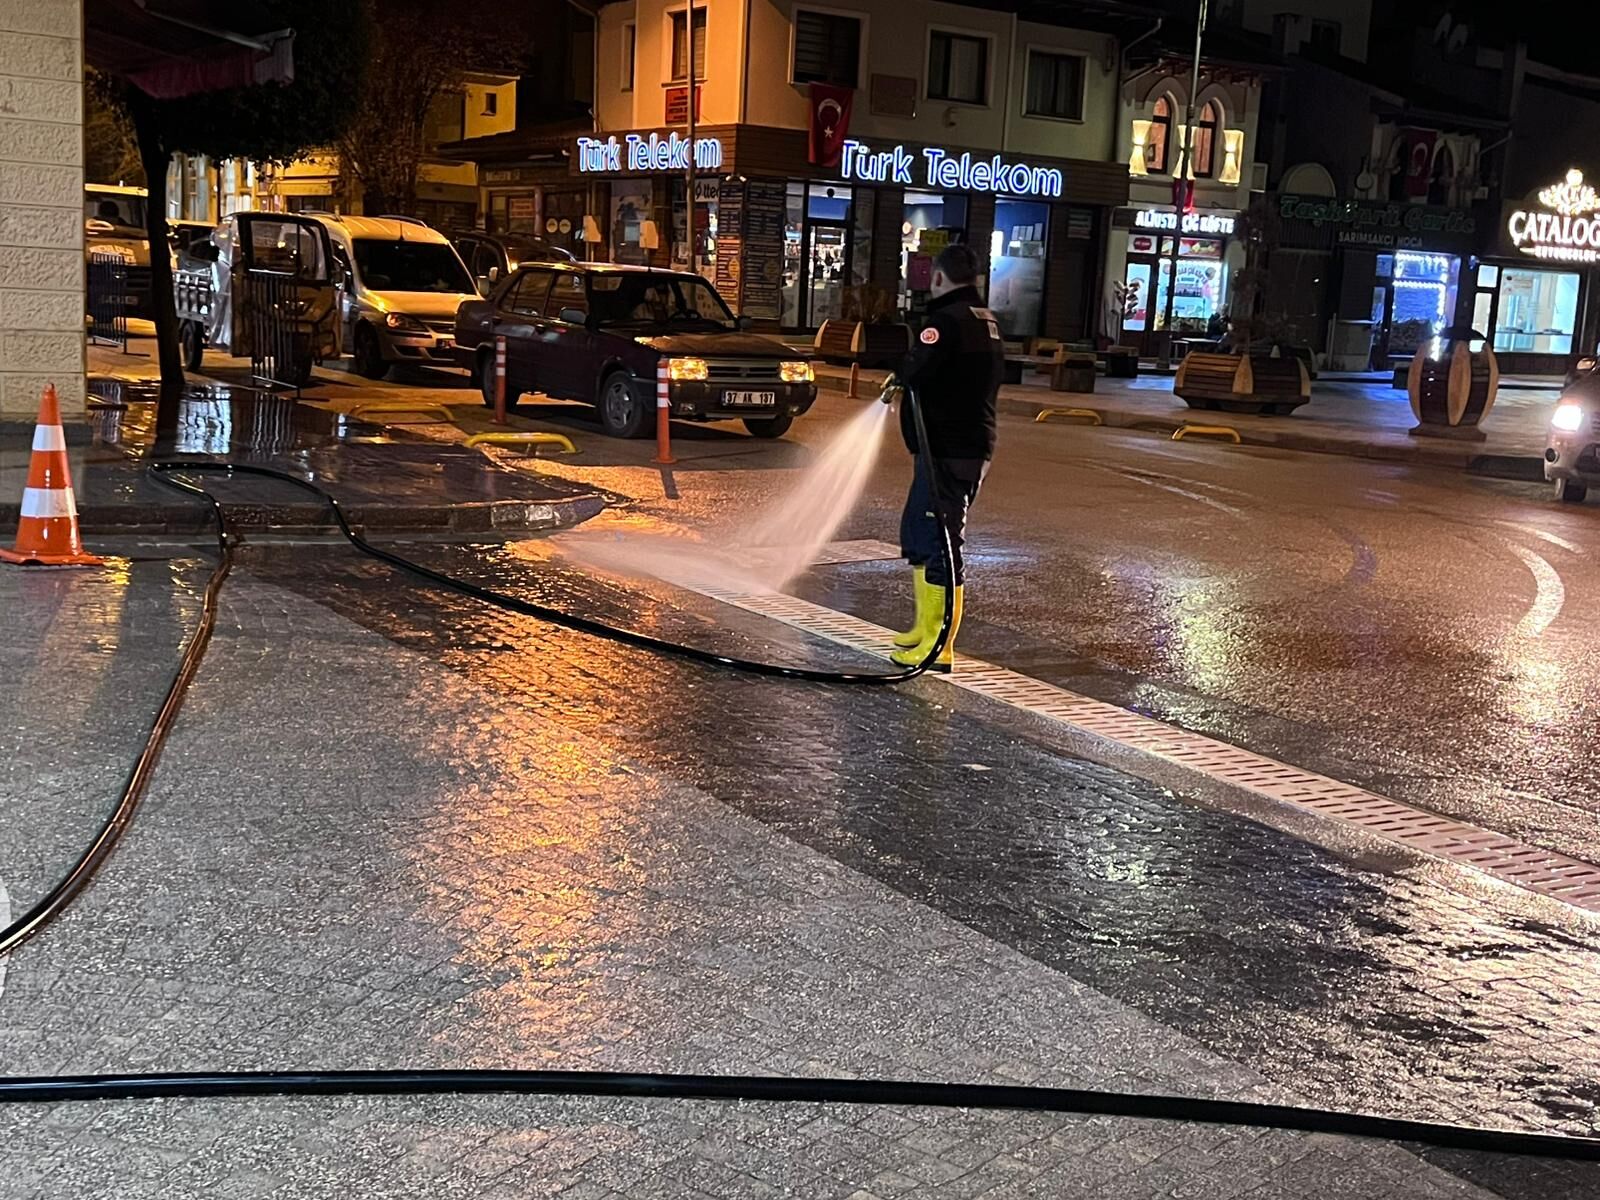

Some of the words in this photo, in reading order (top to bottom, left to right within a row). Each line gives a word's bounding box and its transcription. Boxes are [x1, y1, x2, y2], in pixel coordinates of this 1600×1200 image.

[577, 136, 621, 172] Türk
[841, 140, 914, 183] Türk
[923, 148, 1062, 197] Telekom
[1508, 211, 1600, 247] ÇATALOĞ
[727, 392, 737, 404] 37
[743, 392, 753, 404] AK
